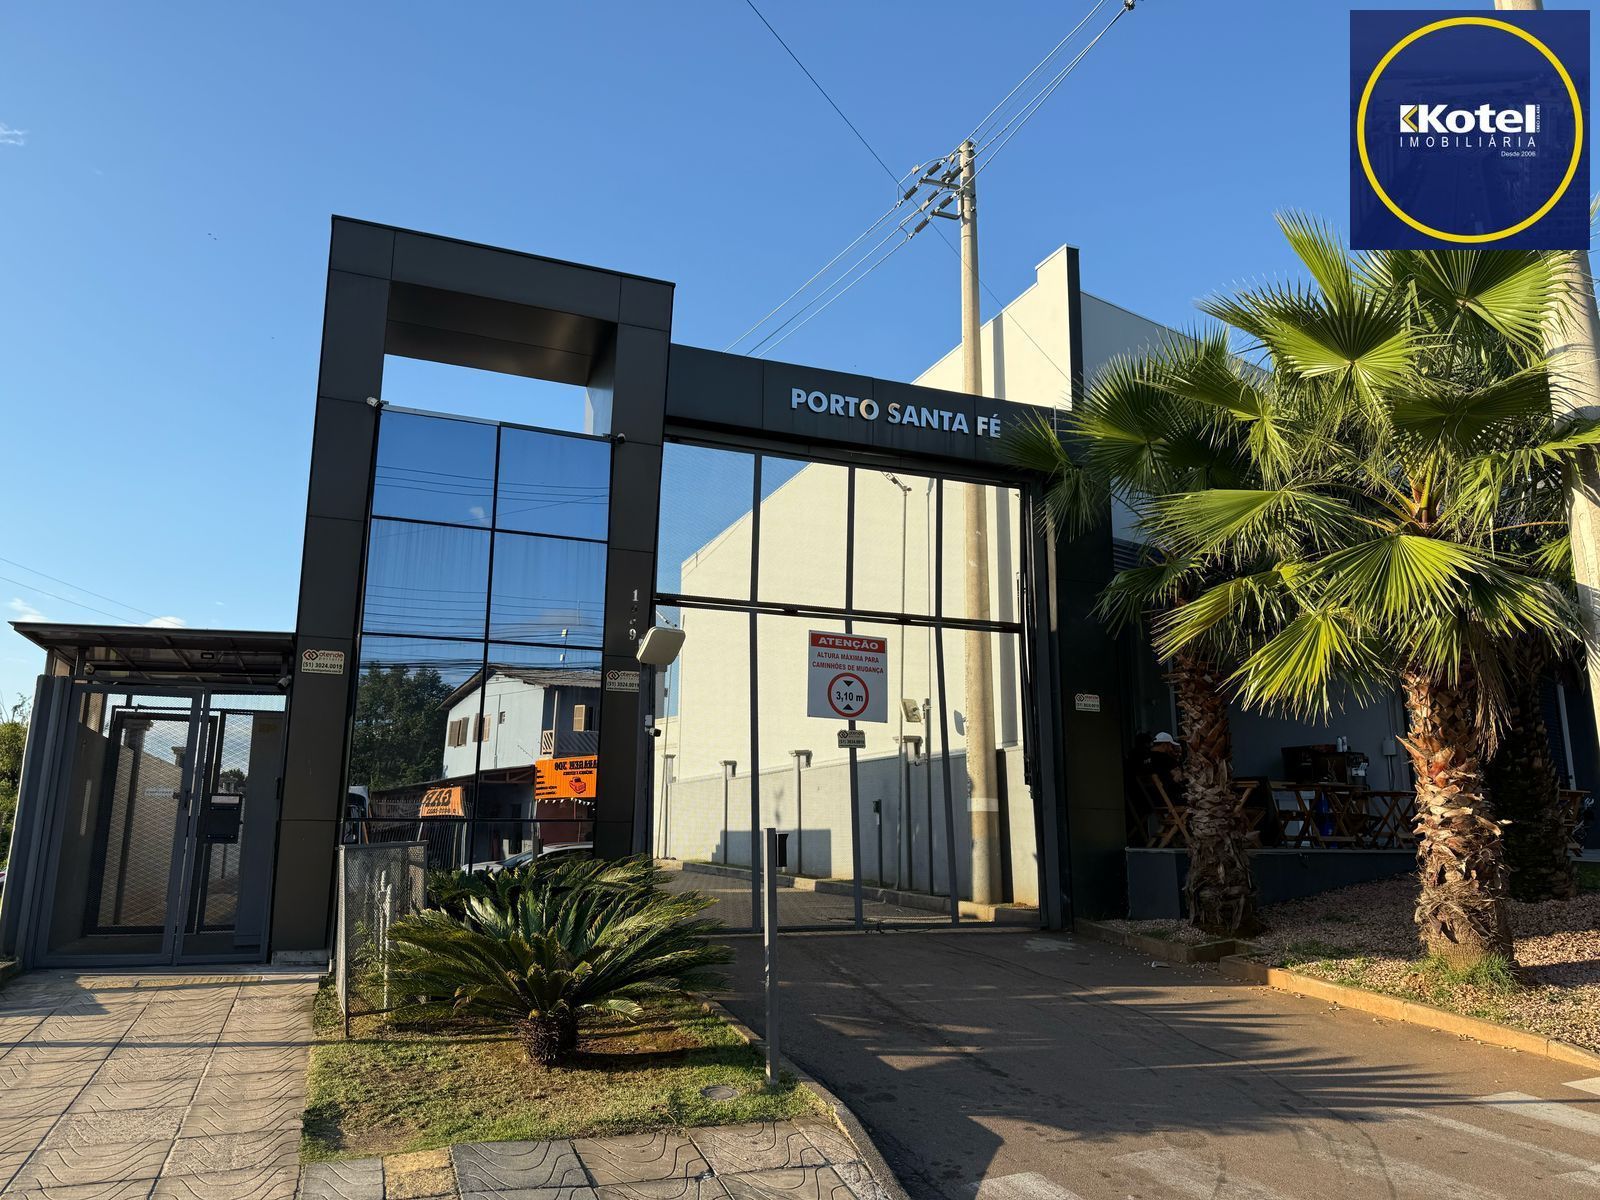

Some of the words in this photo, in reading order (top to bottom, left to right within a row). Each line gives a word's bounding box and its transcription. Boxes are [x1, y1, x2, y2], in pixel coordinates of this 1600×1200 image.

[790, 387, 880, 421] PORTO
[887, 402, 969, 434] SANTA
[976, 413, 1001, 439] FÉ
[818, 636, 879, 650] ATENÇÃO
[816, 651, 840, 660] ALTURA
[840, 653, 863, 662] MÁXIMA
[812, 660, 846, 670] CAMINHÕES
[856, 665, 884, 675] MUDANÇA
[836, 690, 854, 702] 3,10
[856, 694, 864, 702] m
